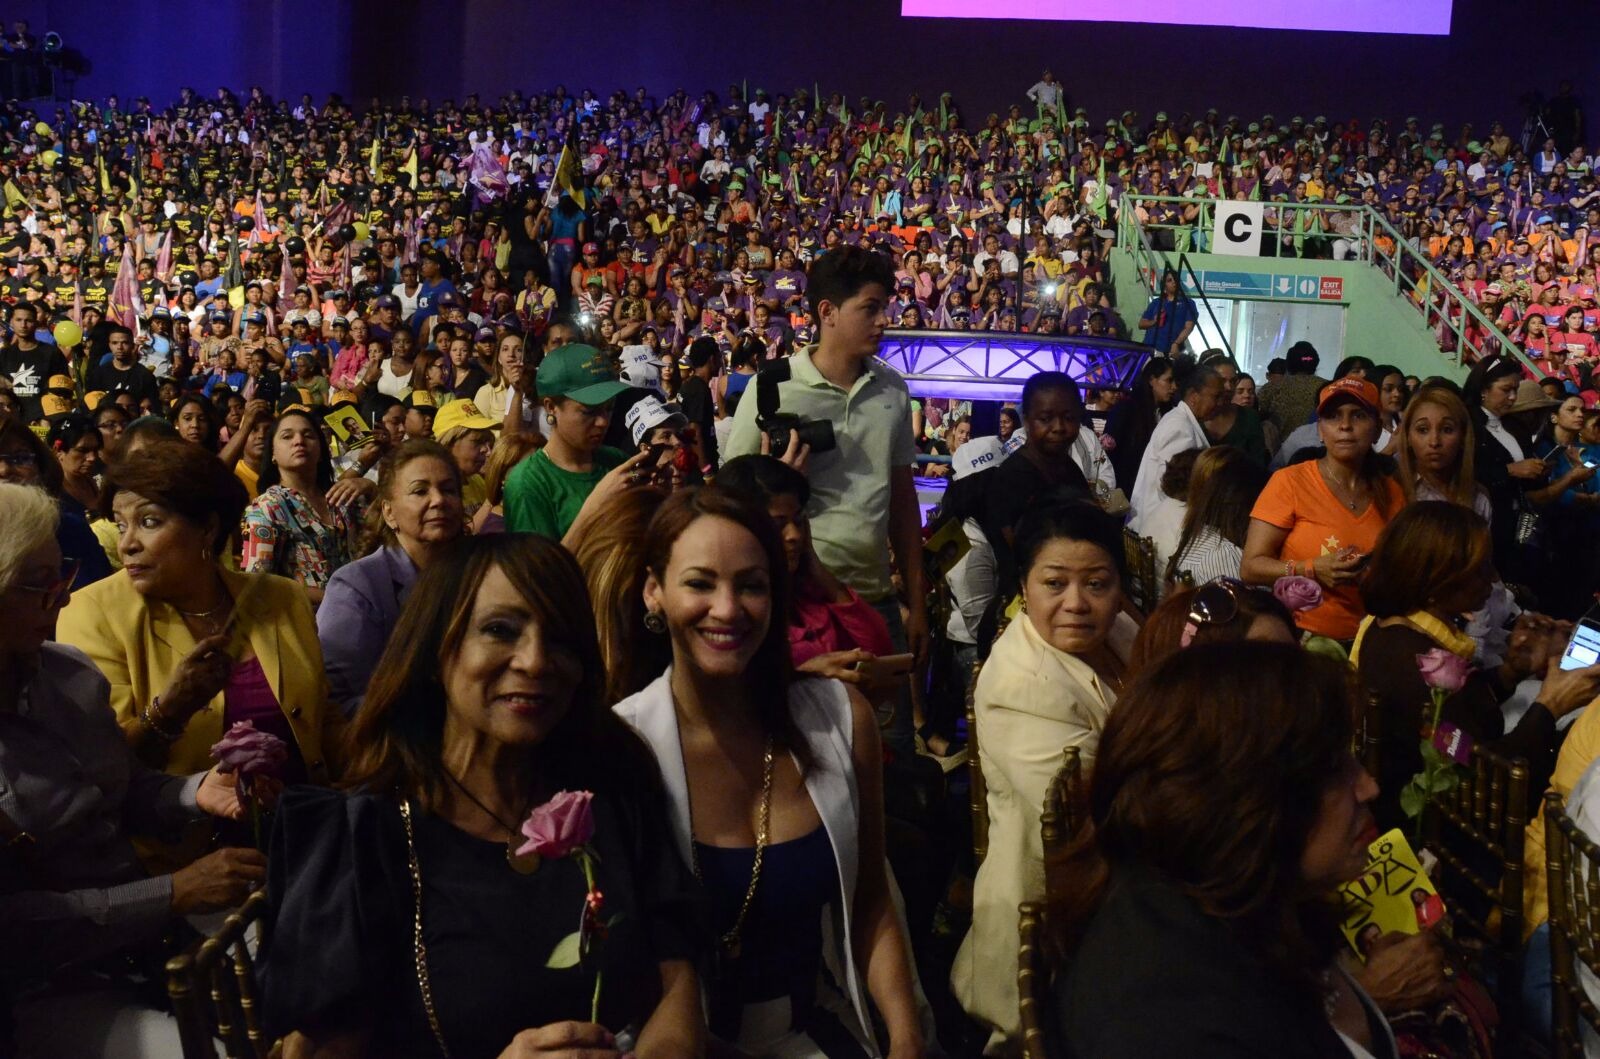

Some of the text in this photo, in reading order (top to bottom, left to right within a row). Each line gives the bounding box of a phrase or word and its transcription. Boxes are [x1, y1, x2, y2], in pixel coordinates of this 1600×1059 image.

[1224, 213, 1253, 242] C
[634, 354, 648, 363] PRD
[971, 452, 994, 468] PRD
